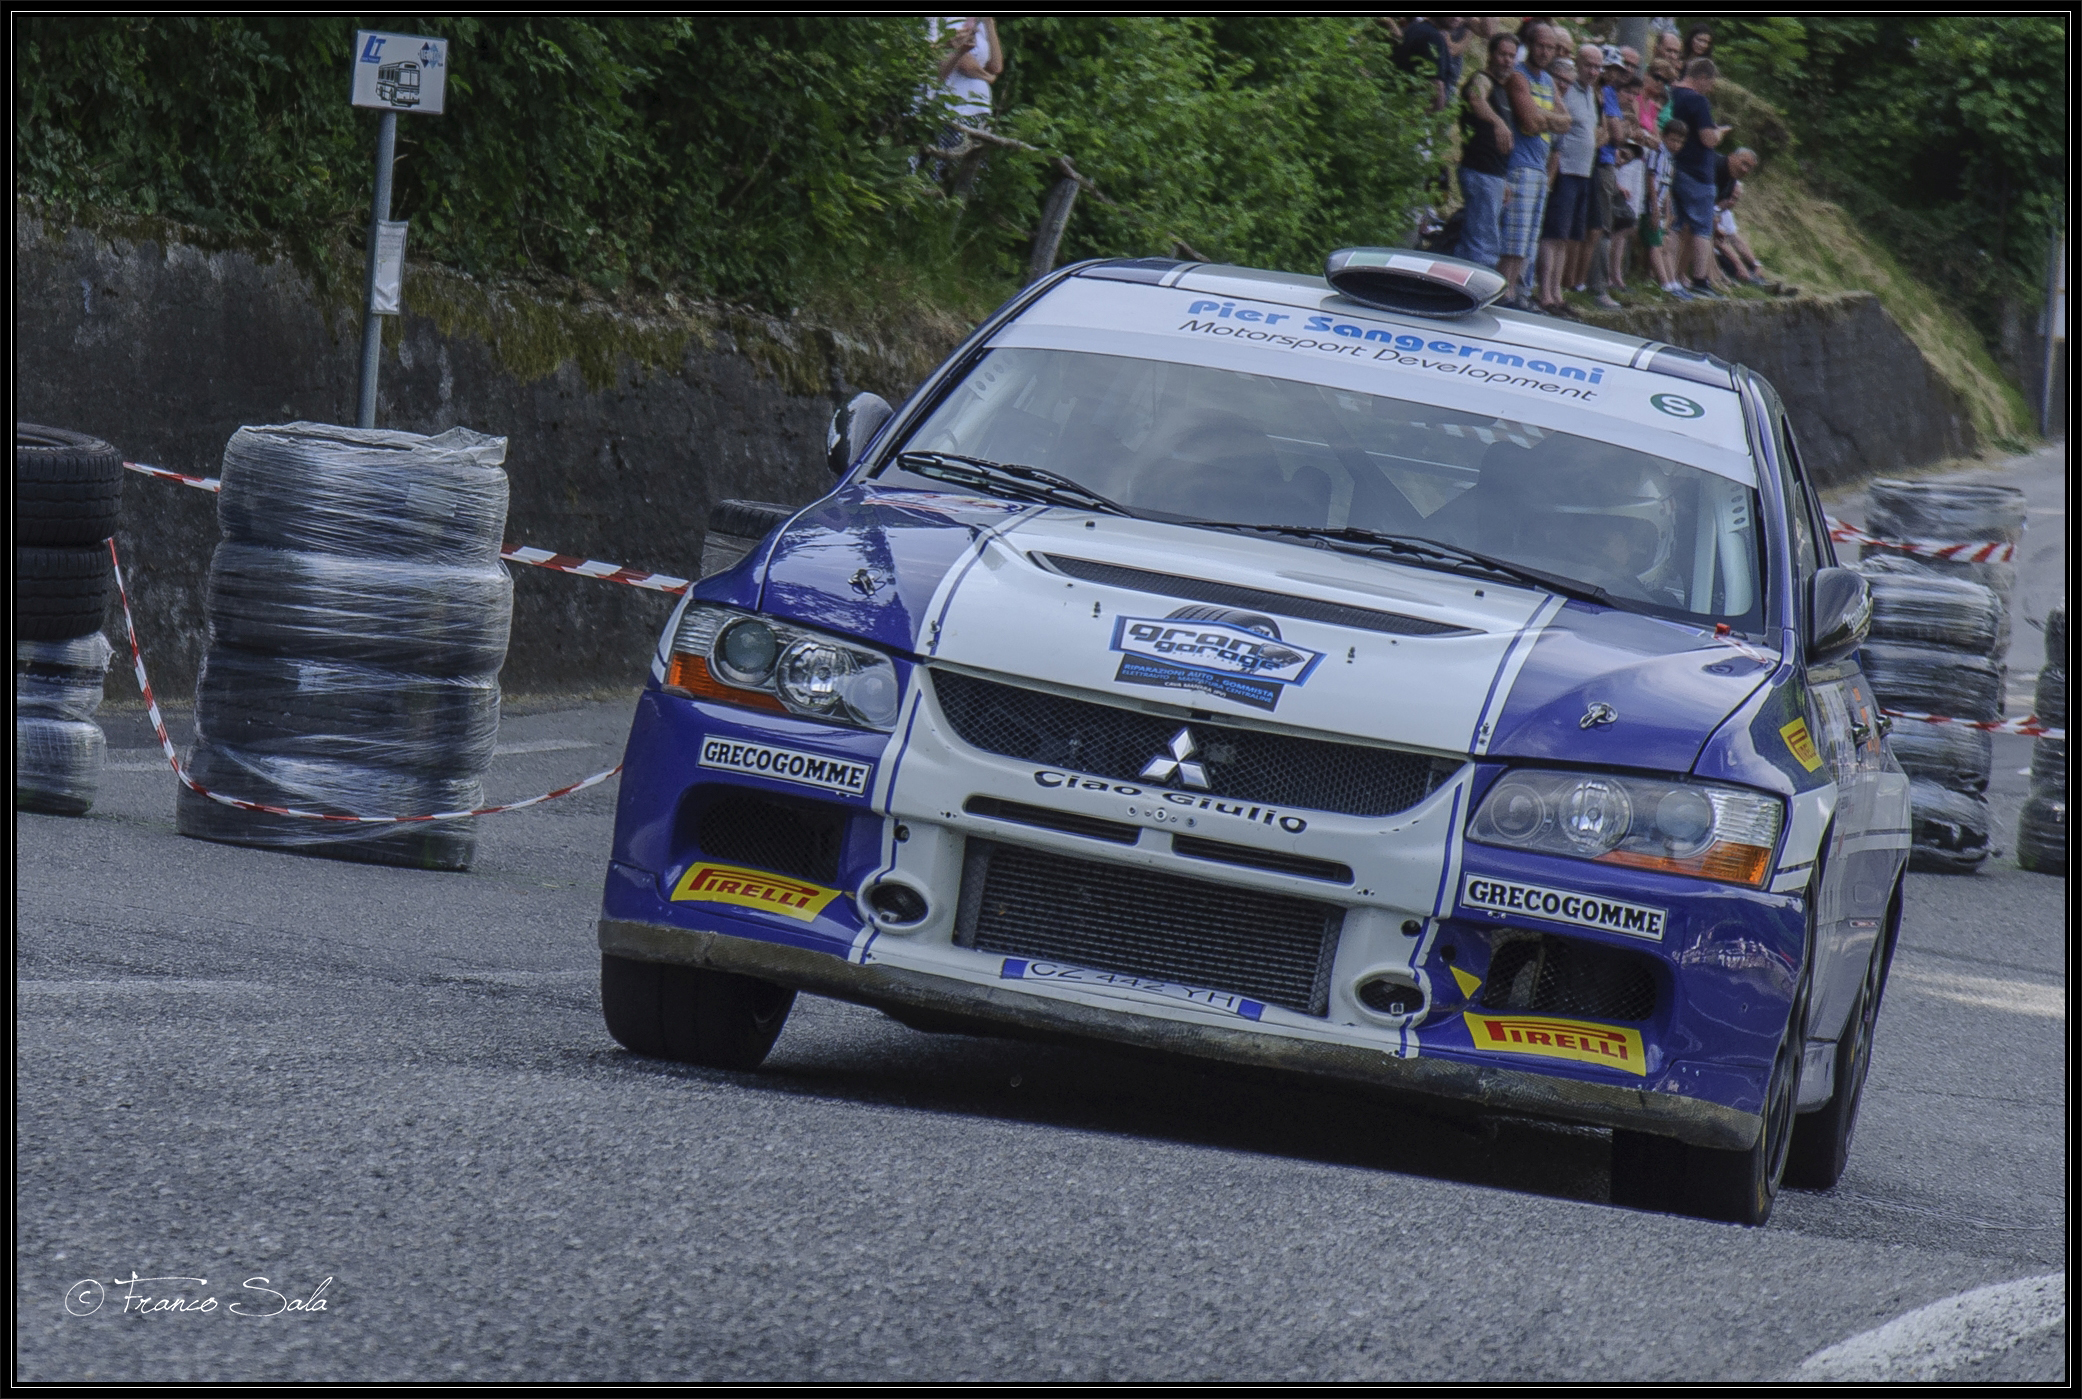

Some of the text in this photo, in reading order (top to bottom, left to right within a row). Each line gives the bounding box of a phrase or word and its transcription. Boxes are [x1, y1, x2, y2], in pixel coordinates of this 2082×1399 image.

[1178, 319, 1598, 402] Motorsport Development
[1187, 300, 1605, 385] Pier Sangermani
[1660, 395, 1695, 417] S
[1128, 623, 1263, 656] gran
[1153, 640, 1284, 671] garage
[1124, 663, 1274, 698] RIPARAZIONI AUTO GOMMISTA
[703, 740, 865, 790] GRECOGOMME
[1033, 770, 1308, 834] Ciao Giulio
[688, 867, 820, 910] PIRELLI
[1468, 879, 1664, 937] GRECOGOMME
[1030, 962, 1235, 1009] CZ 442 YH
[1483, 1020, 1629, 1061] PIRELLI
